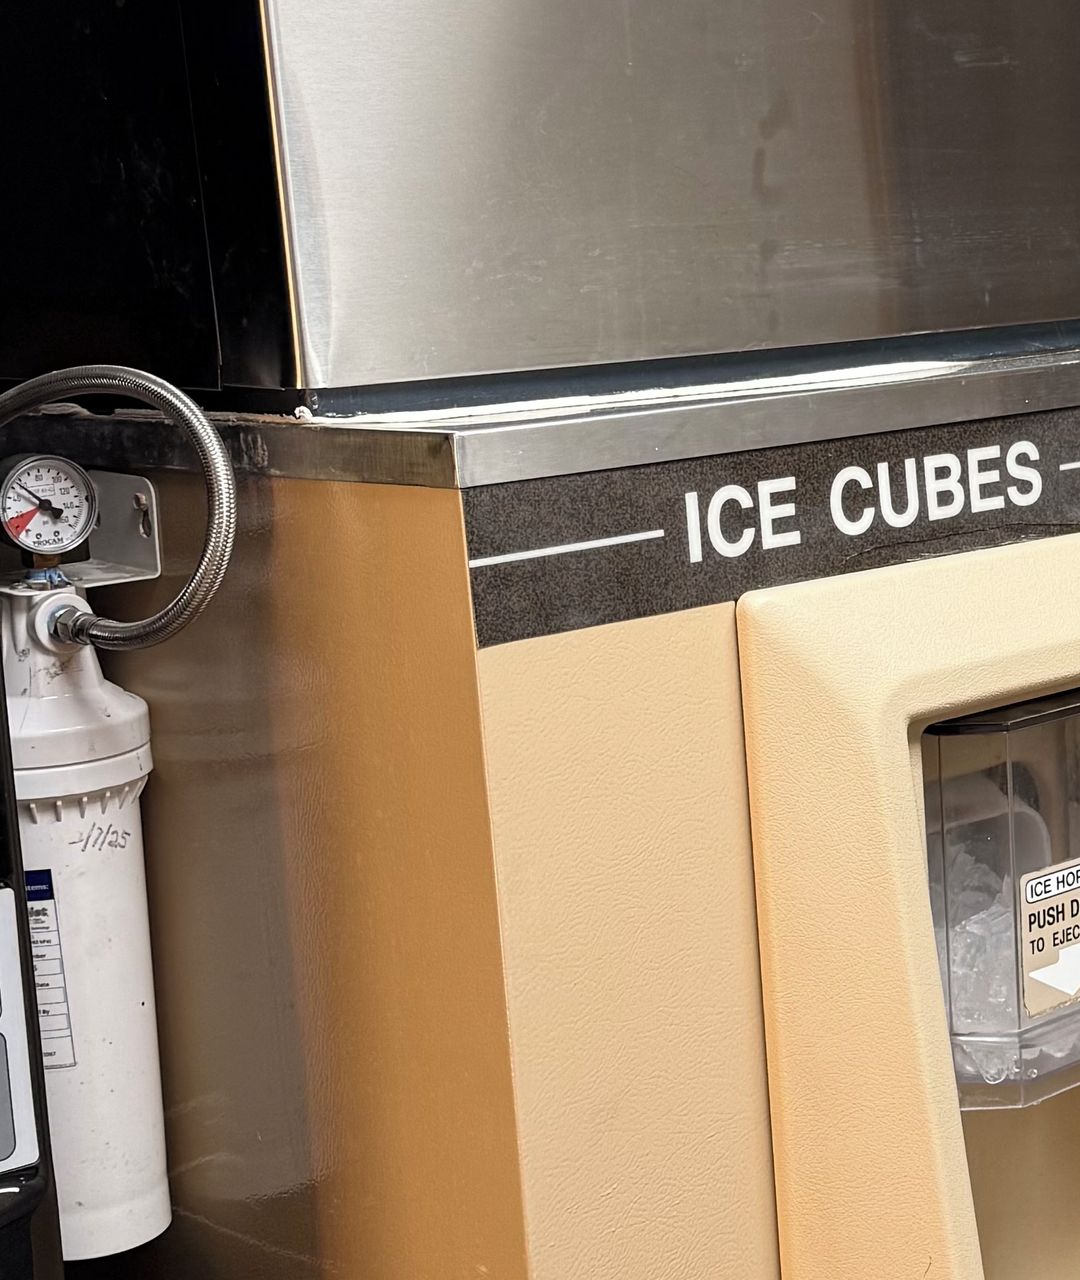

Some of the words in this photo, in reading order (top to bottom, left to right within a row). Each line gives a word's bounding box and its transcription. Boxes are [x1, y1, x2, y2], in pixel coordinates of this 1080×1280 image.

[684, 476, 802, 564] ICE
[829, 440, 1043, 536] CUBES
[1030, 878, 1052, 898] ICE
[1028, 902, 1065, 933] PUSH
[1029, 937, 1045, 955] TO
